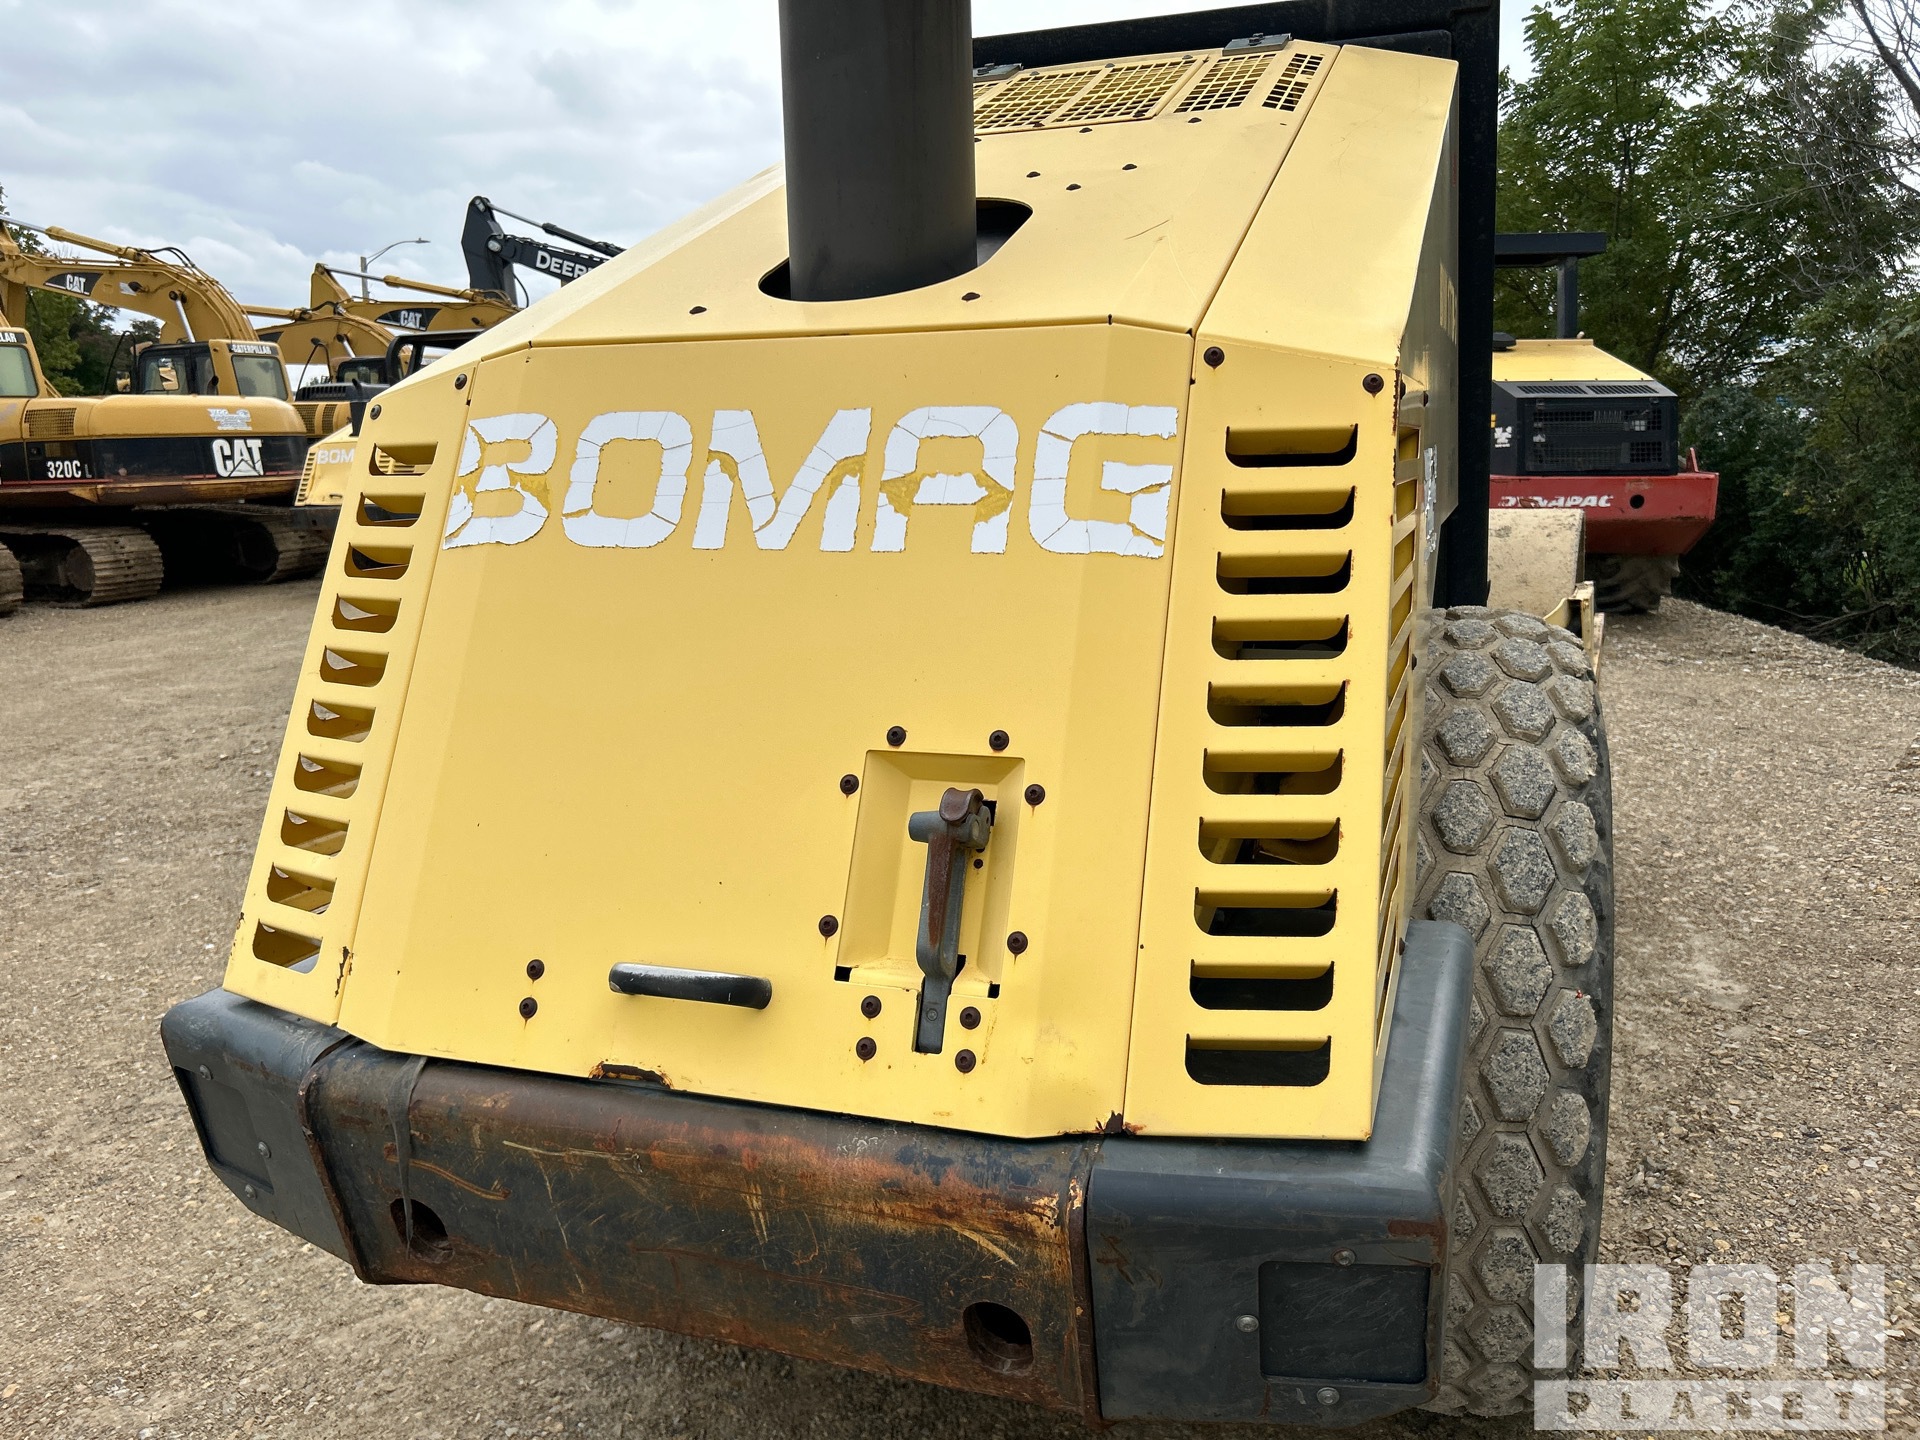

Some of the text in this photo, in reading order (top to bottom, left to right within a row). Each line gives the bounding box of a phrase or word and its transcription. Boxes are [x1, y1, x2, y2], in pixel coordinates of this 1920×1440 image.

[535, 250, 593, 278] DEER
[66, 274, 86, 294] CAT
[400, 310, 422, 329] CAT
[0, 332, 17, 343] LAR
[231, 344, 271, 354] CATERPILLAR
[213, 438, 264, 477] CAT
[46, 460, 92, 478] 320C L
[442, 402, 1180, 558] BOMAG
[1498, 495, 1614, 507] DNAPAC
